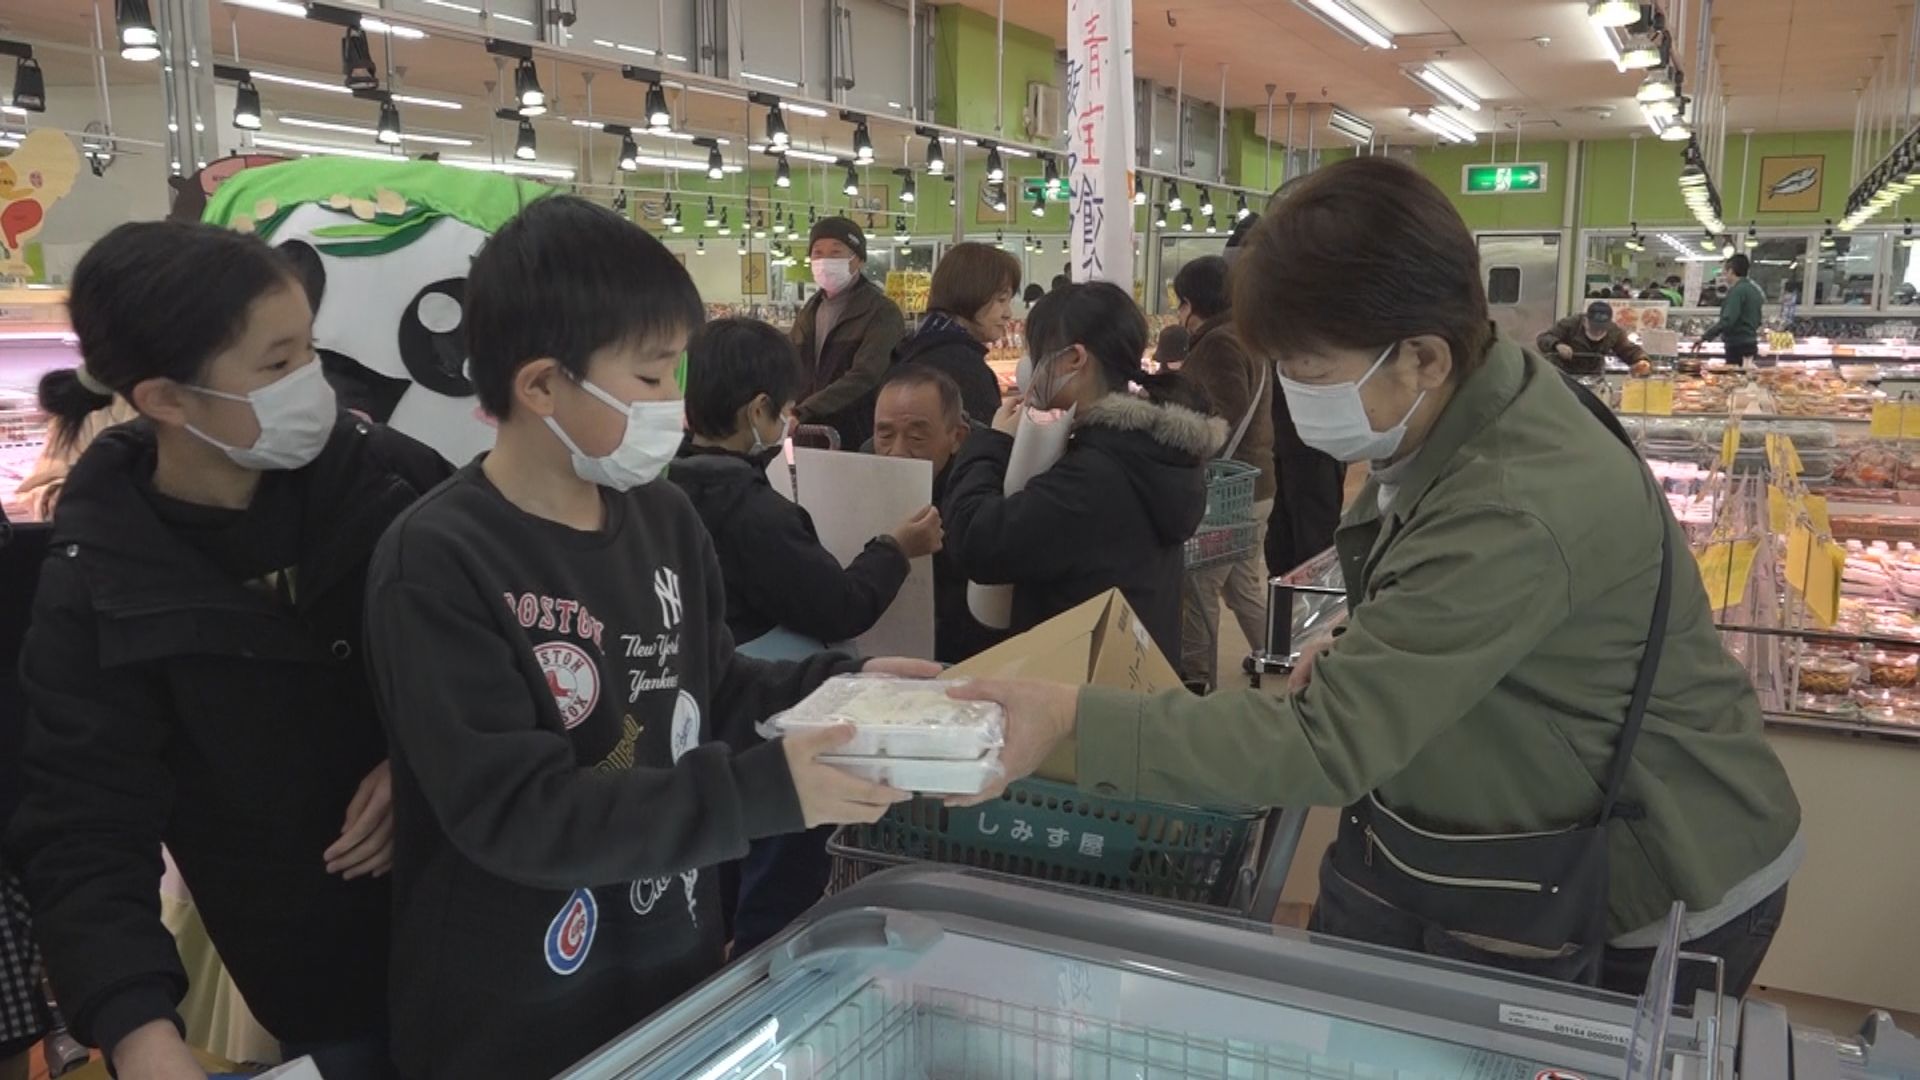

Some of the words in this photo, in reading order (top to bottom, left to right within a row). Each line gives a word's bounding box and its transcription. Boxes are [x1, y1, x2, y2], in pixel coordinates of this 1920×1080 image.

[620, 634, 657, 657] New
[540, 652, 585, 674] STON
[978, 811, 1105, 858] しみず屋
